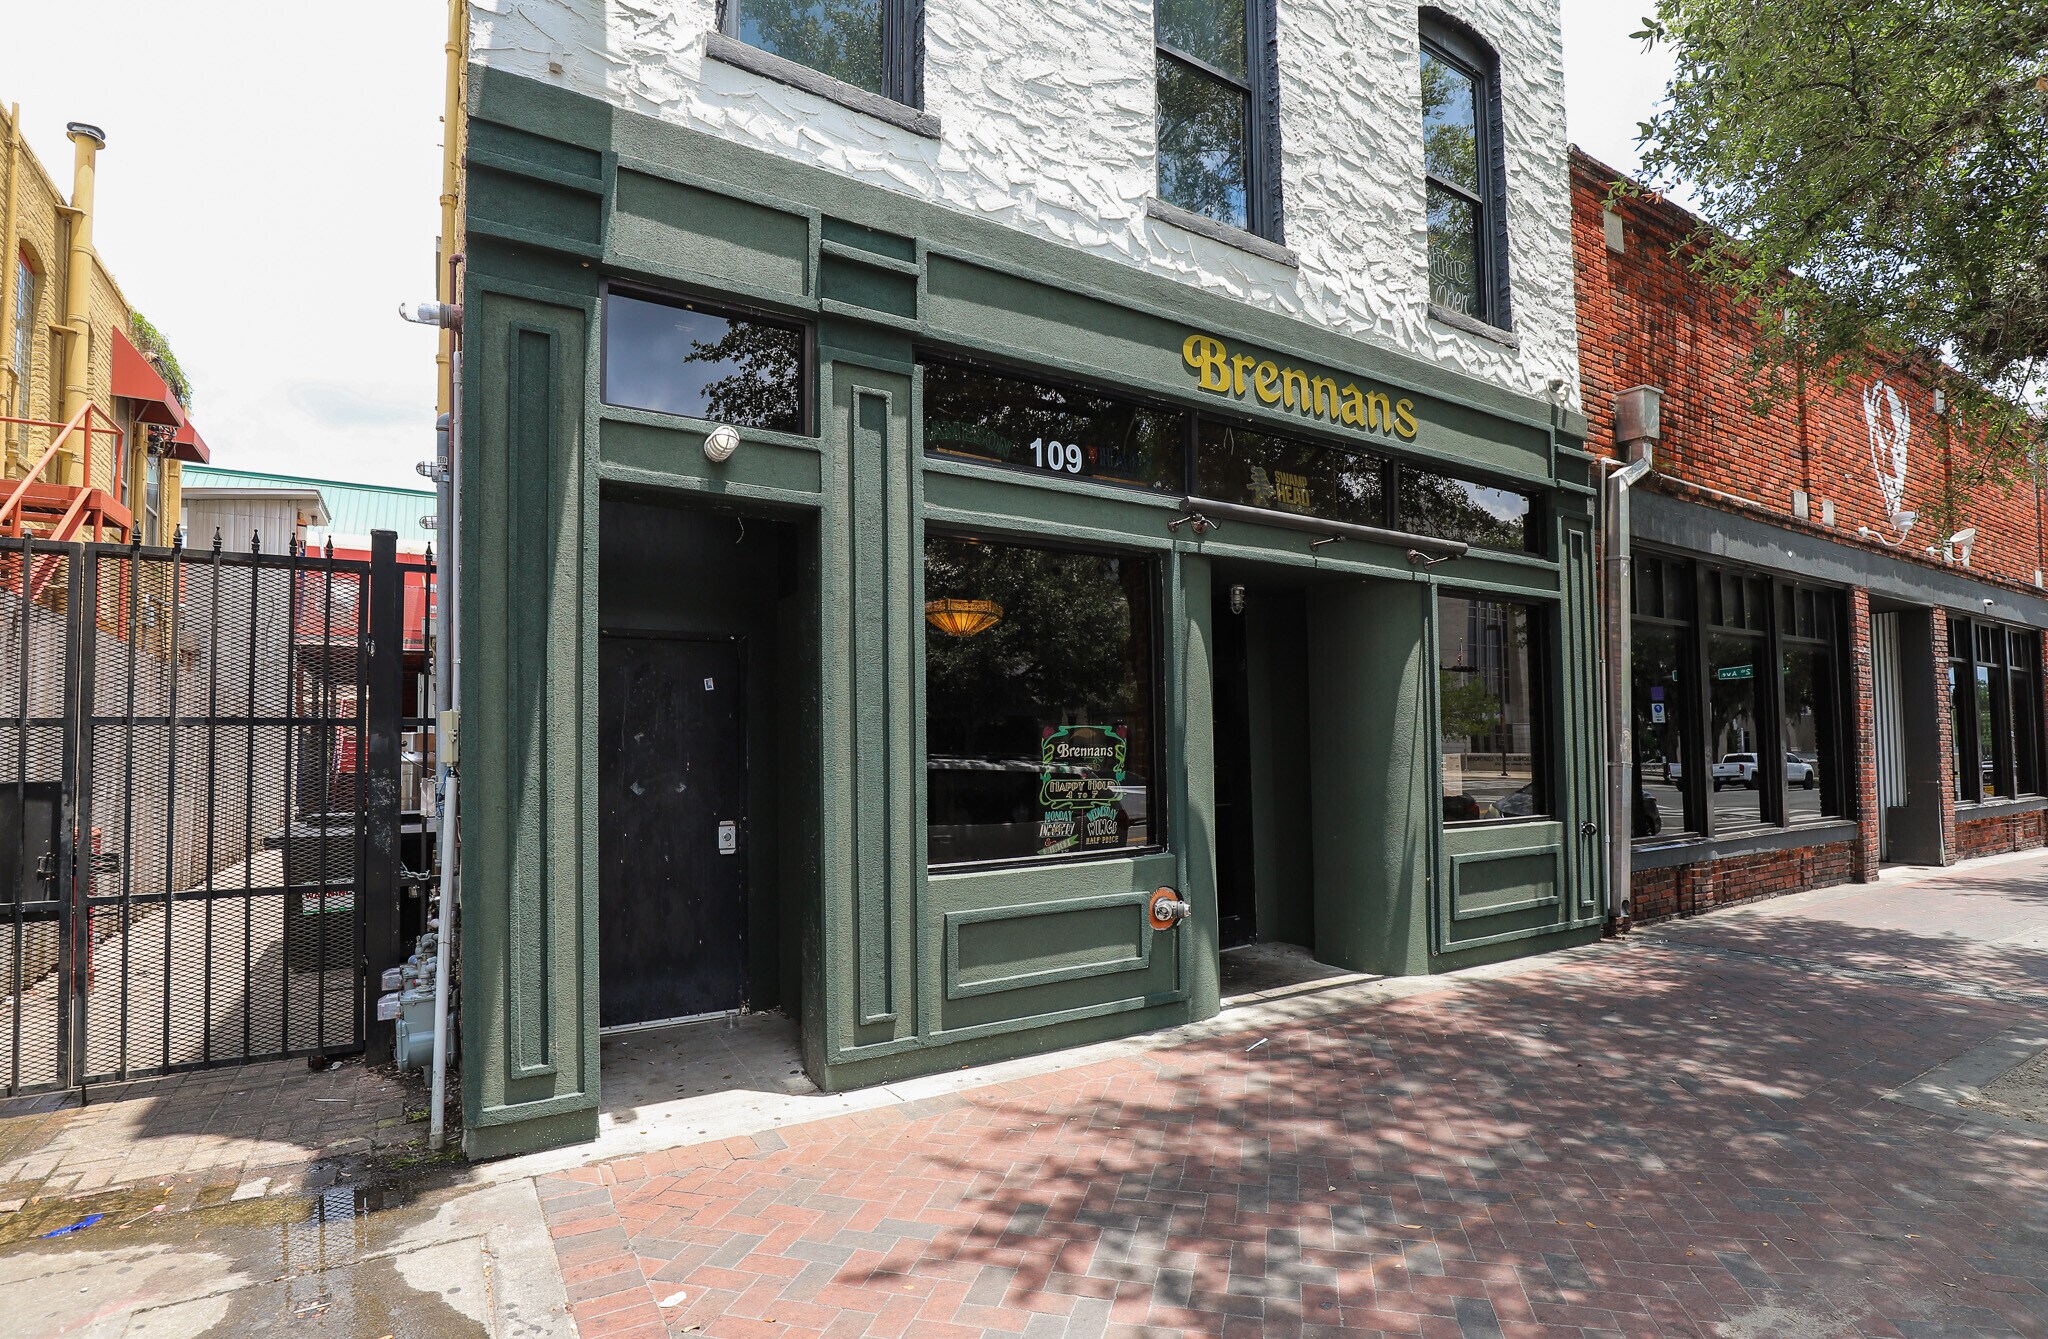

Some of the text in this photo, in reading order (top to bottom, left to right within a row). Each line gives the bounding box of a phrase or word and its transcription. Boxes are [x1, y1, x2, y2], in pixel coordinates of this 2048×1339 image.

[1183, 334, 1418, 437] Brennans
[1029, 437, 1083, 474] 109
[1274, 470, 1308, 488] SWAMP
[1275, 484, 1311, 507] HEAD
[1057, 743, 1114, 758] Brennans
[1049, 781, 1085, 793] HAPPY
[1045, 810, 1074, 823] MONDAY
[1087, 819, 1117, 836] WINGS
